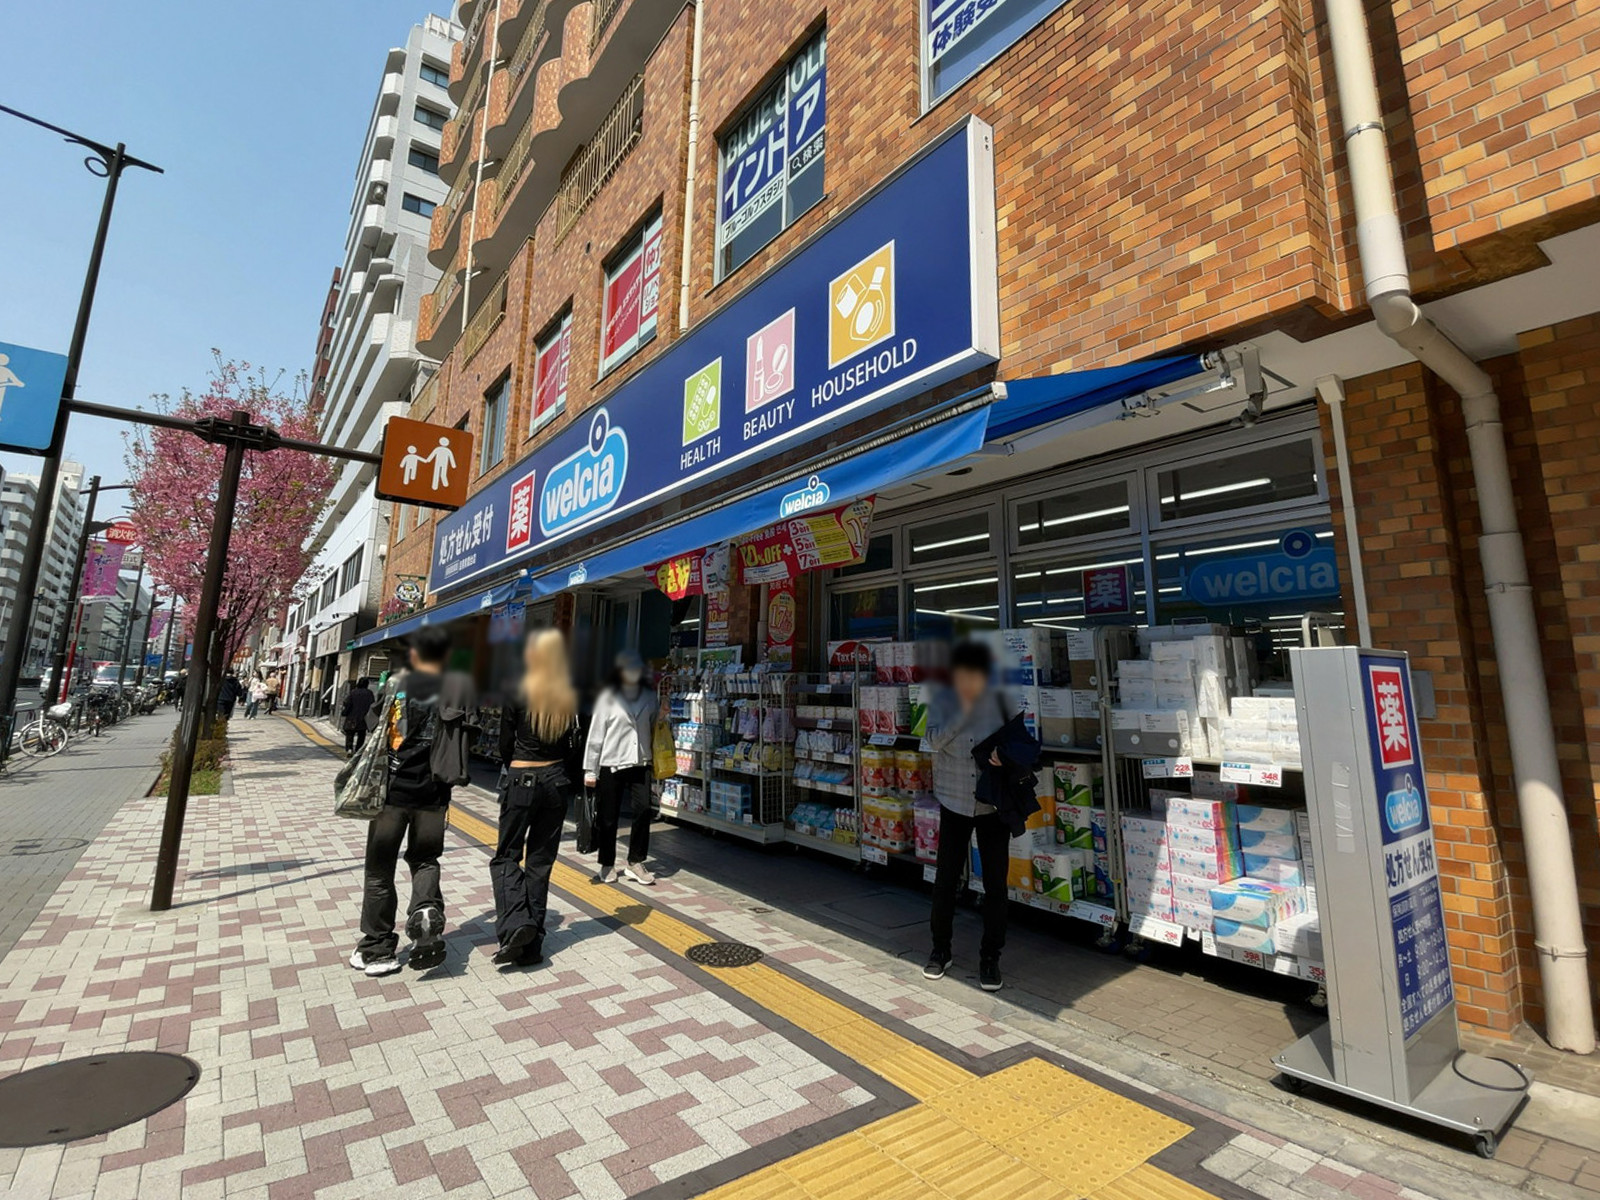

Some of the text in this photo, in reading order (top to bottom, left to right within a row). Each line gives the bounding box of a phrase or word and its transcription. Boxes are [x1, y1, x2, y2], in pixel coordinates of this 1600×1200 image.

[725, 78, 821, 211] インドア
[726, 95, 772, 169] BLUE
[802, 135, 824, 164] 検索
[811, 338, 917, 408] HOUSEHOLD
[743, 398, 795, 441] BEAUTY
[680, 436, 721, 471] HEALTH
[546, 453, 615, 524] welcia
[785, 490, 824, 515] welcia
[511, 485, 531, 541] 薬
[109, 528, 137, 540] 消火栓
[438, 503, 494, 566] 処方せん受付
[1089, 572, 1122, 607] 薬
[1202, 561, 1335, 598] welcia
[835, 651, 867, 662] Tax Fee
[1377, 681, 1407, 751] 薬
[1261, 772, 1278, 780] 348
[1389, 797, 1420, 826] welcia
[1385, 836, 1435, 888] 処方せん受付
[1243, 950, 1260, 961] 398
